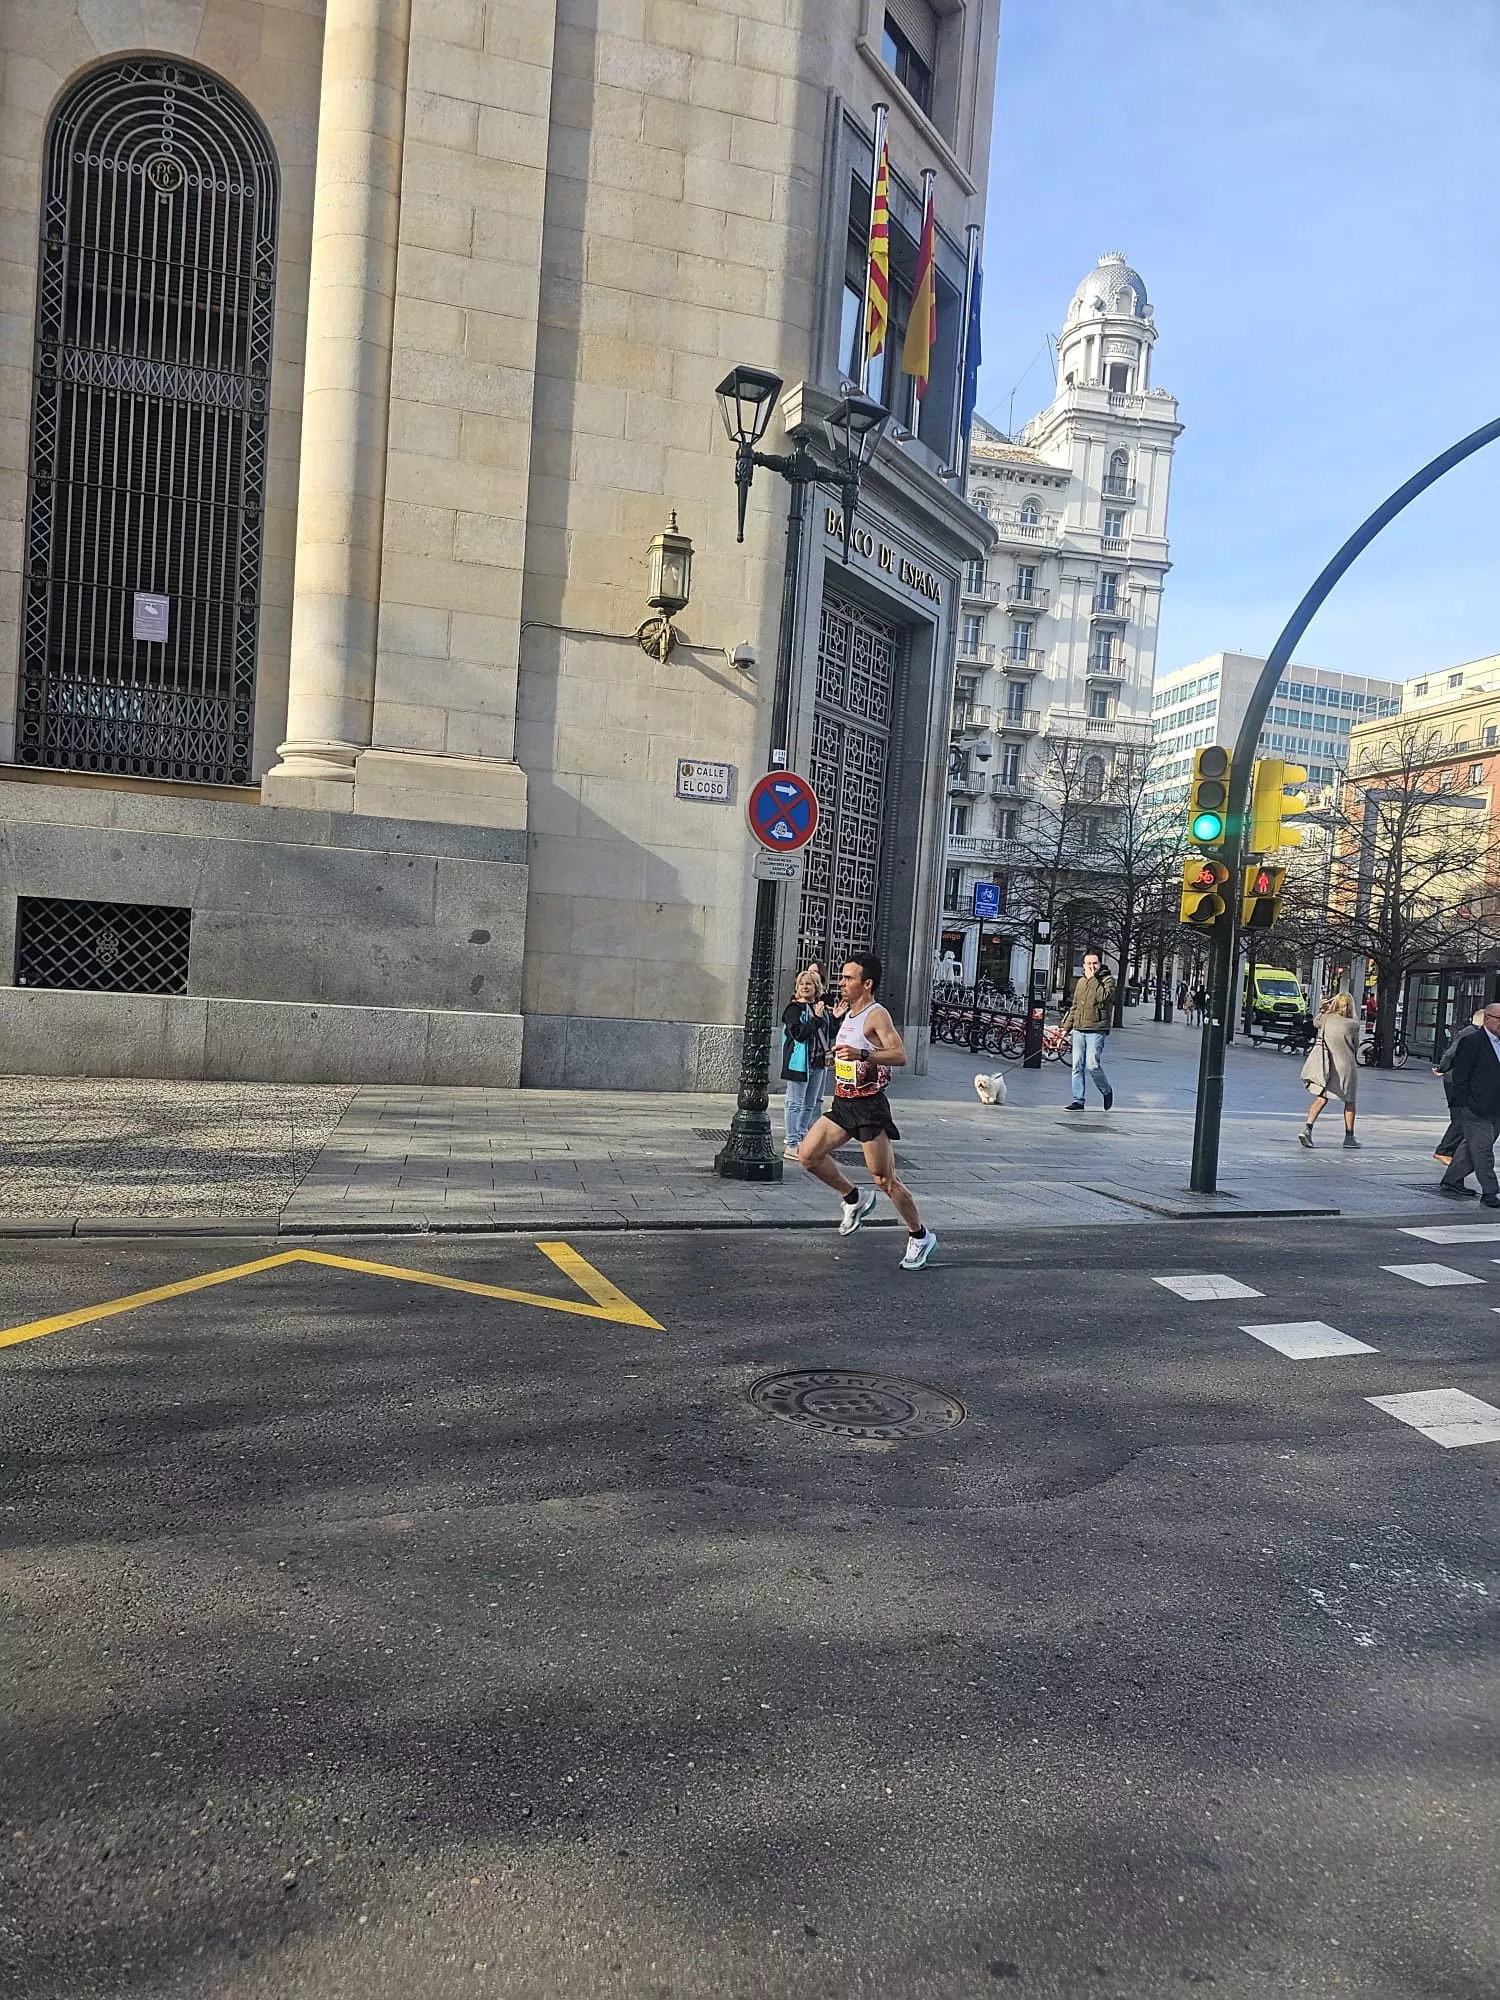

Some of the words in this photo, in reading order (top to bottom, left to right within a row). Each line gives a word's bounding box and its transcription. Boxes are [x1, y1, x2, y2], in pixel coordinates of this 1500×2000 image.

[880, 543, 896, 574] DE
[901, 557, 943, 605] ESPAÑA
[696, 767, 725, 778] CALLE
[683, 780, 694, 791] EL
[697, 782, 723, 794] COSO
